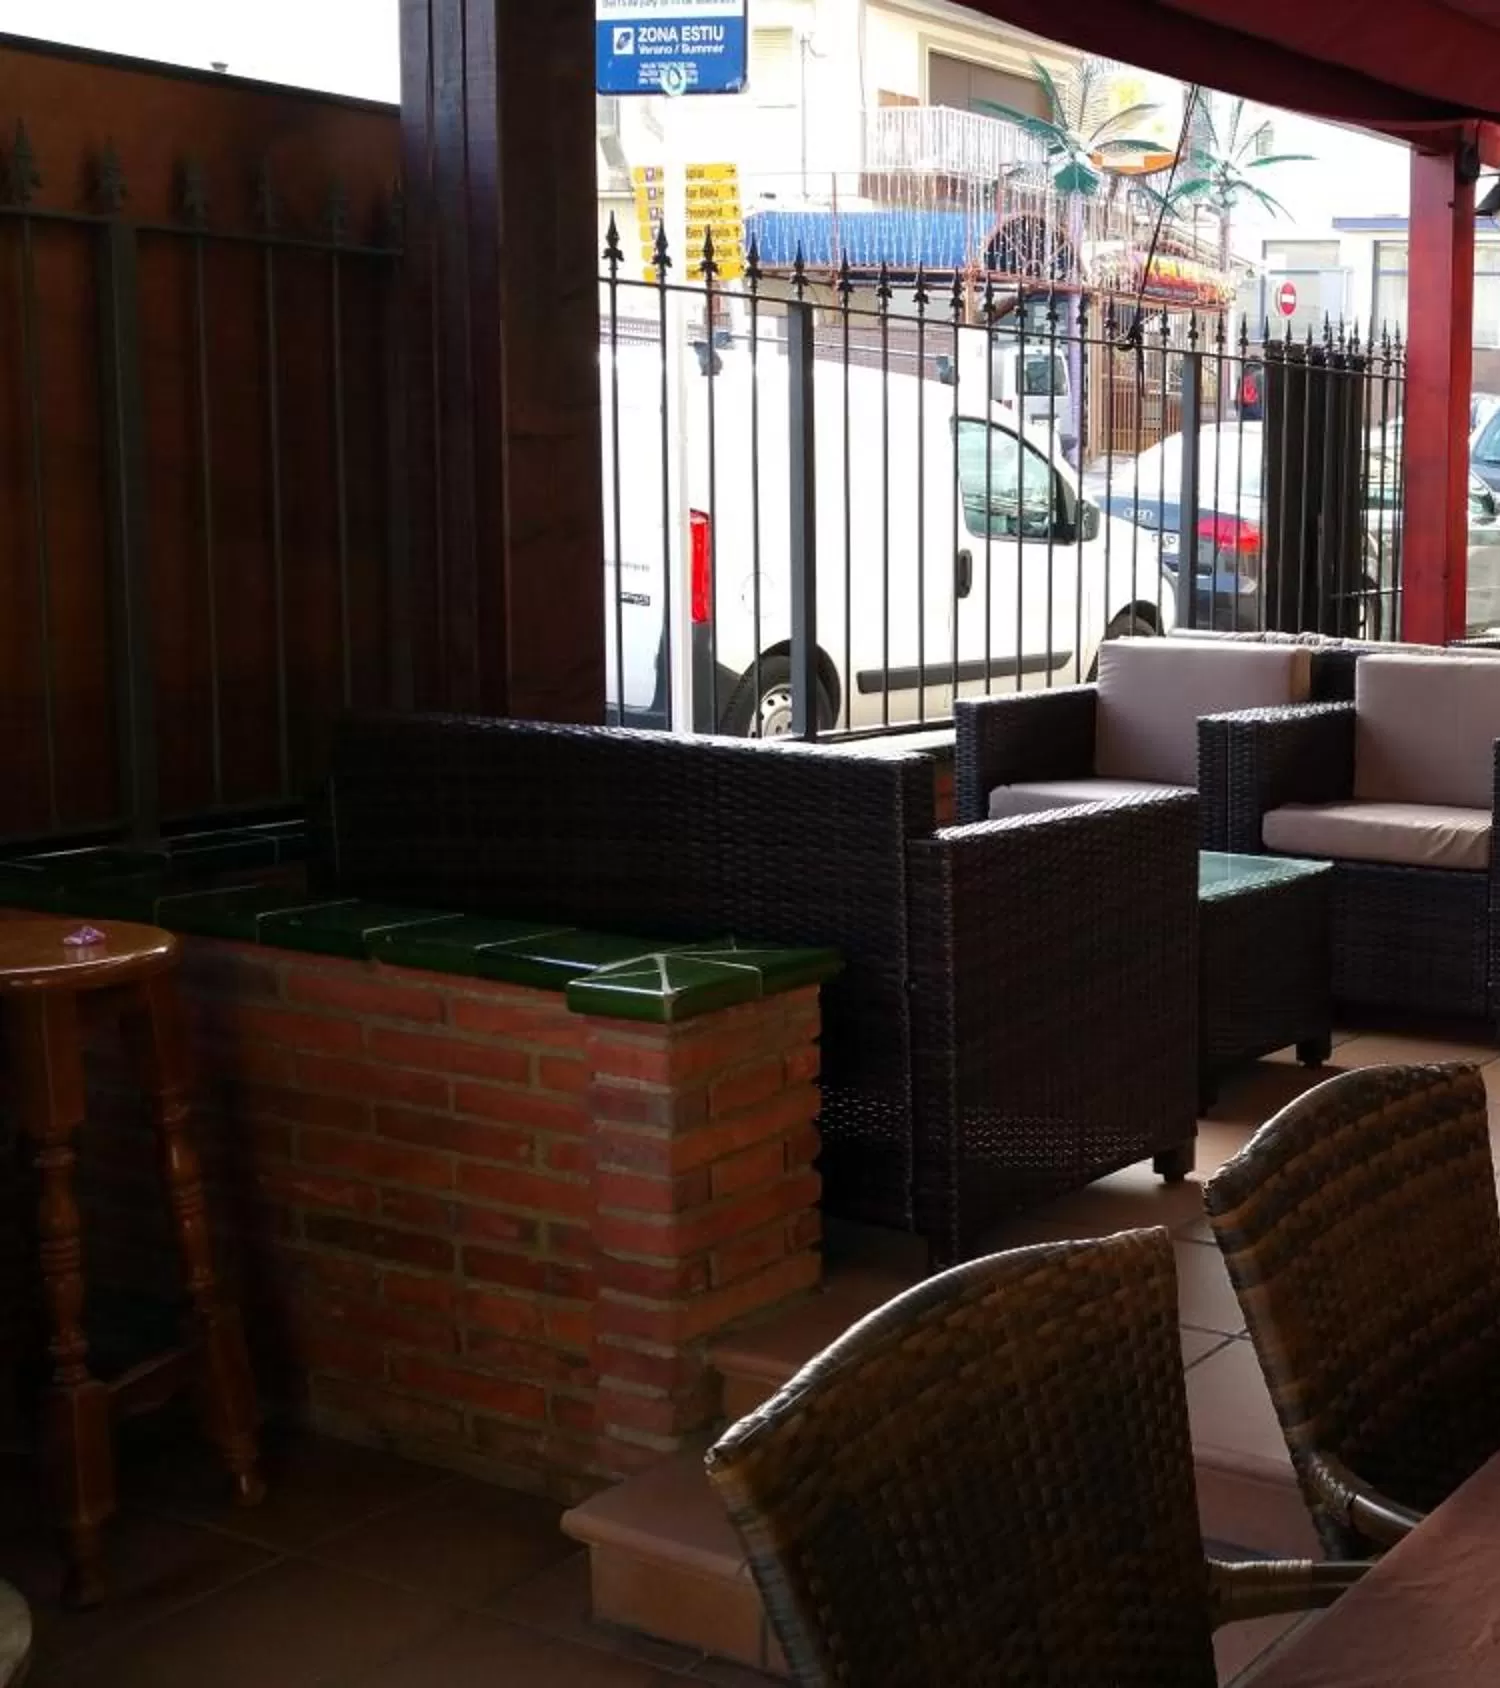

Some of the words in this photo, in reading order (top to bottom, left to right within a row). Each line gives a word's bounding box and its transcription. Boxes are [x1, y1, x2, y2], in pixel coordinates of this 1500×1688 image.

[638, 26, 678, 42] ZONA
[681, 24, 724, 42] ESTIU
[638, 43, 673, 55] Verano
[681, 43, 725, 55] Summer
